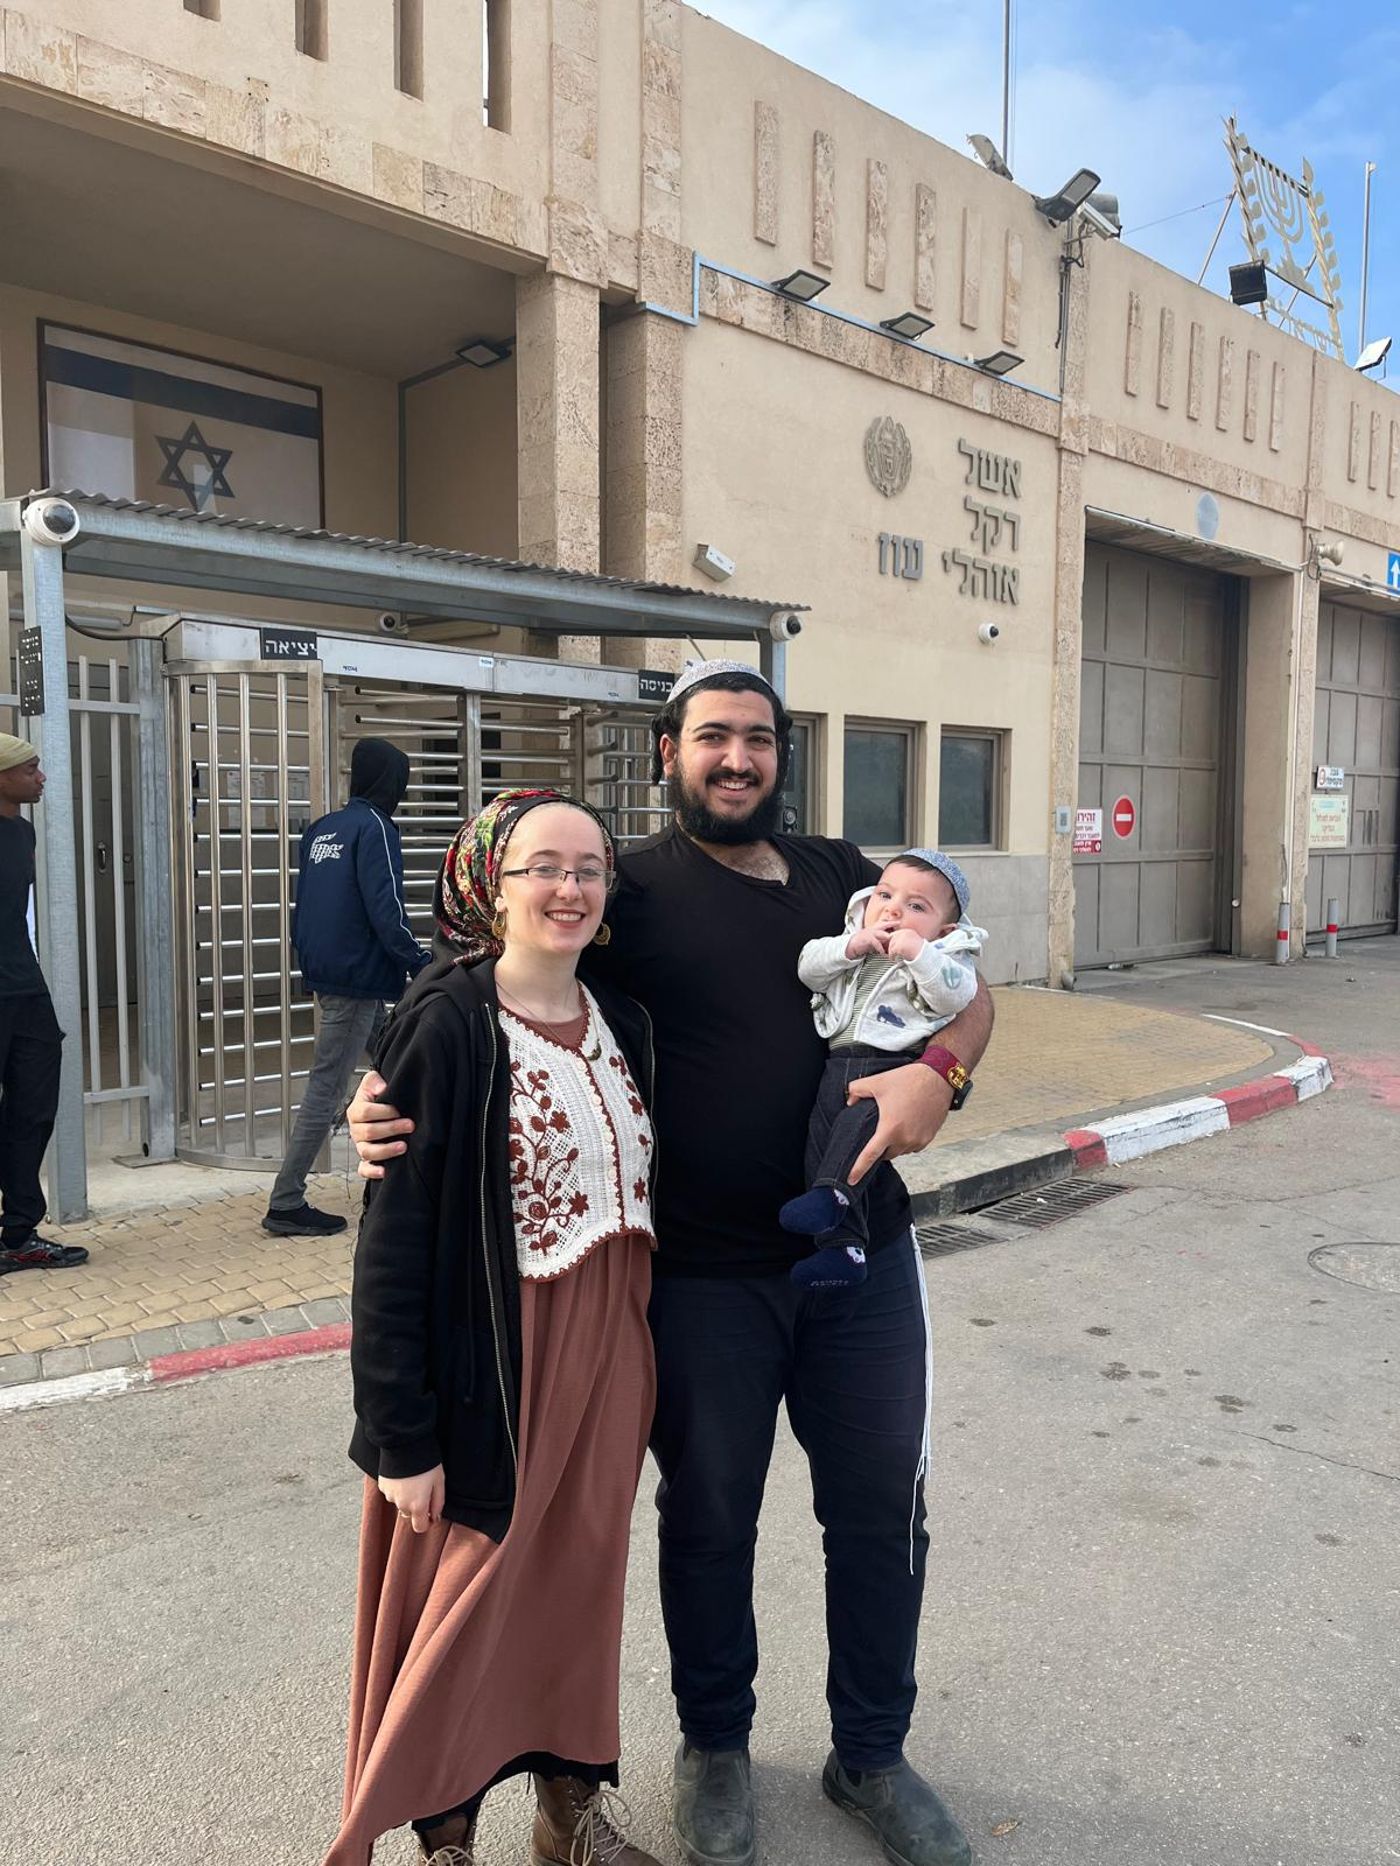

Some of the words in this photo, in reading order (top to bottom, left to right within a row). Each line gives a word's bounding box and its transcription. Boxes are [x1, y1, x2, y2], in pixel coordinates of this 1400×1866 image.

[958, 438, 1021, 499] אשל
[878, 532, 924, 580] עוז
[942, 548, 1020, 606] אוהלי
[265, 640, 315, 656] יציאה
[640, 679, 673, 693] כניסה
